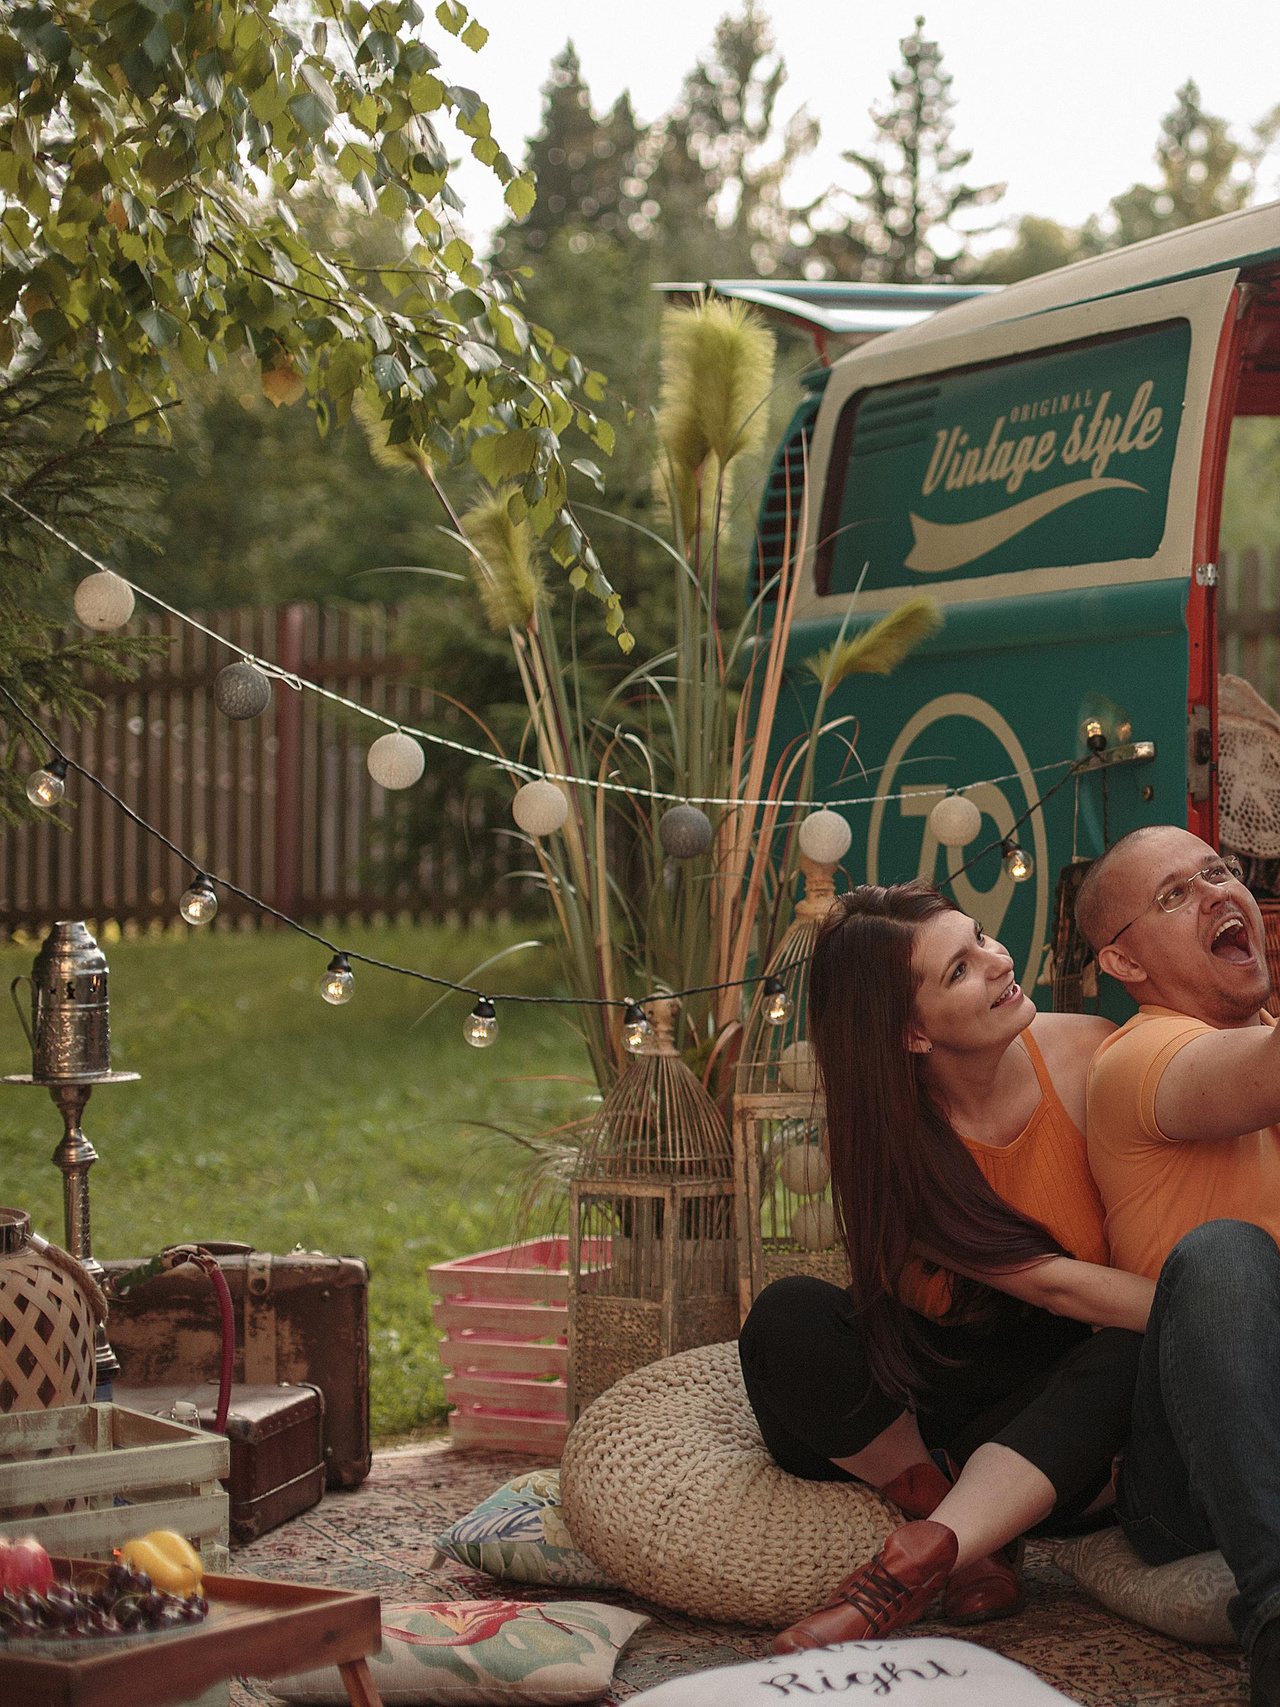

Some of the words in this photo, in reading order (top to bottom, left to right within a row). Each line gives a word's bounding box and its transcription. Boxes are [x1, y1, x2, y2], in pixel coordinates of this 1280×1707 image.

[1009, 389, 1093, 424] ORIGINAL
[921, 415, 1057, 497] Vintage
[1061, 379, 1164, 479] style
[758, 1658, 969, 1697] Right
